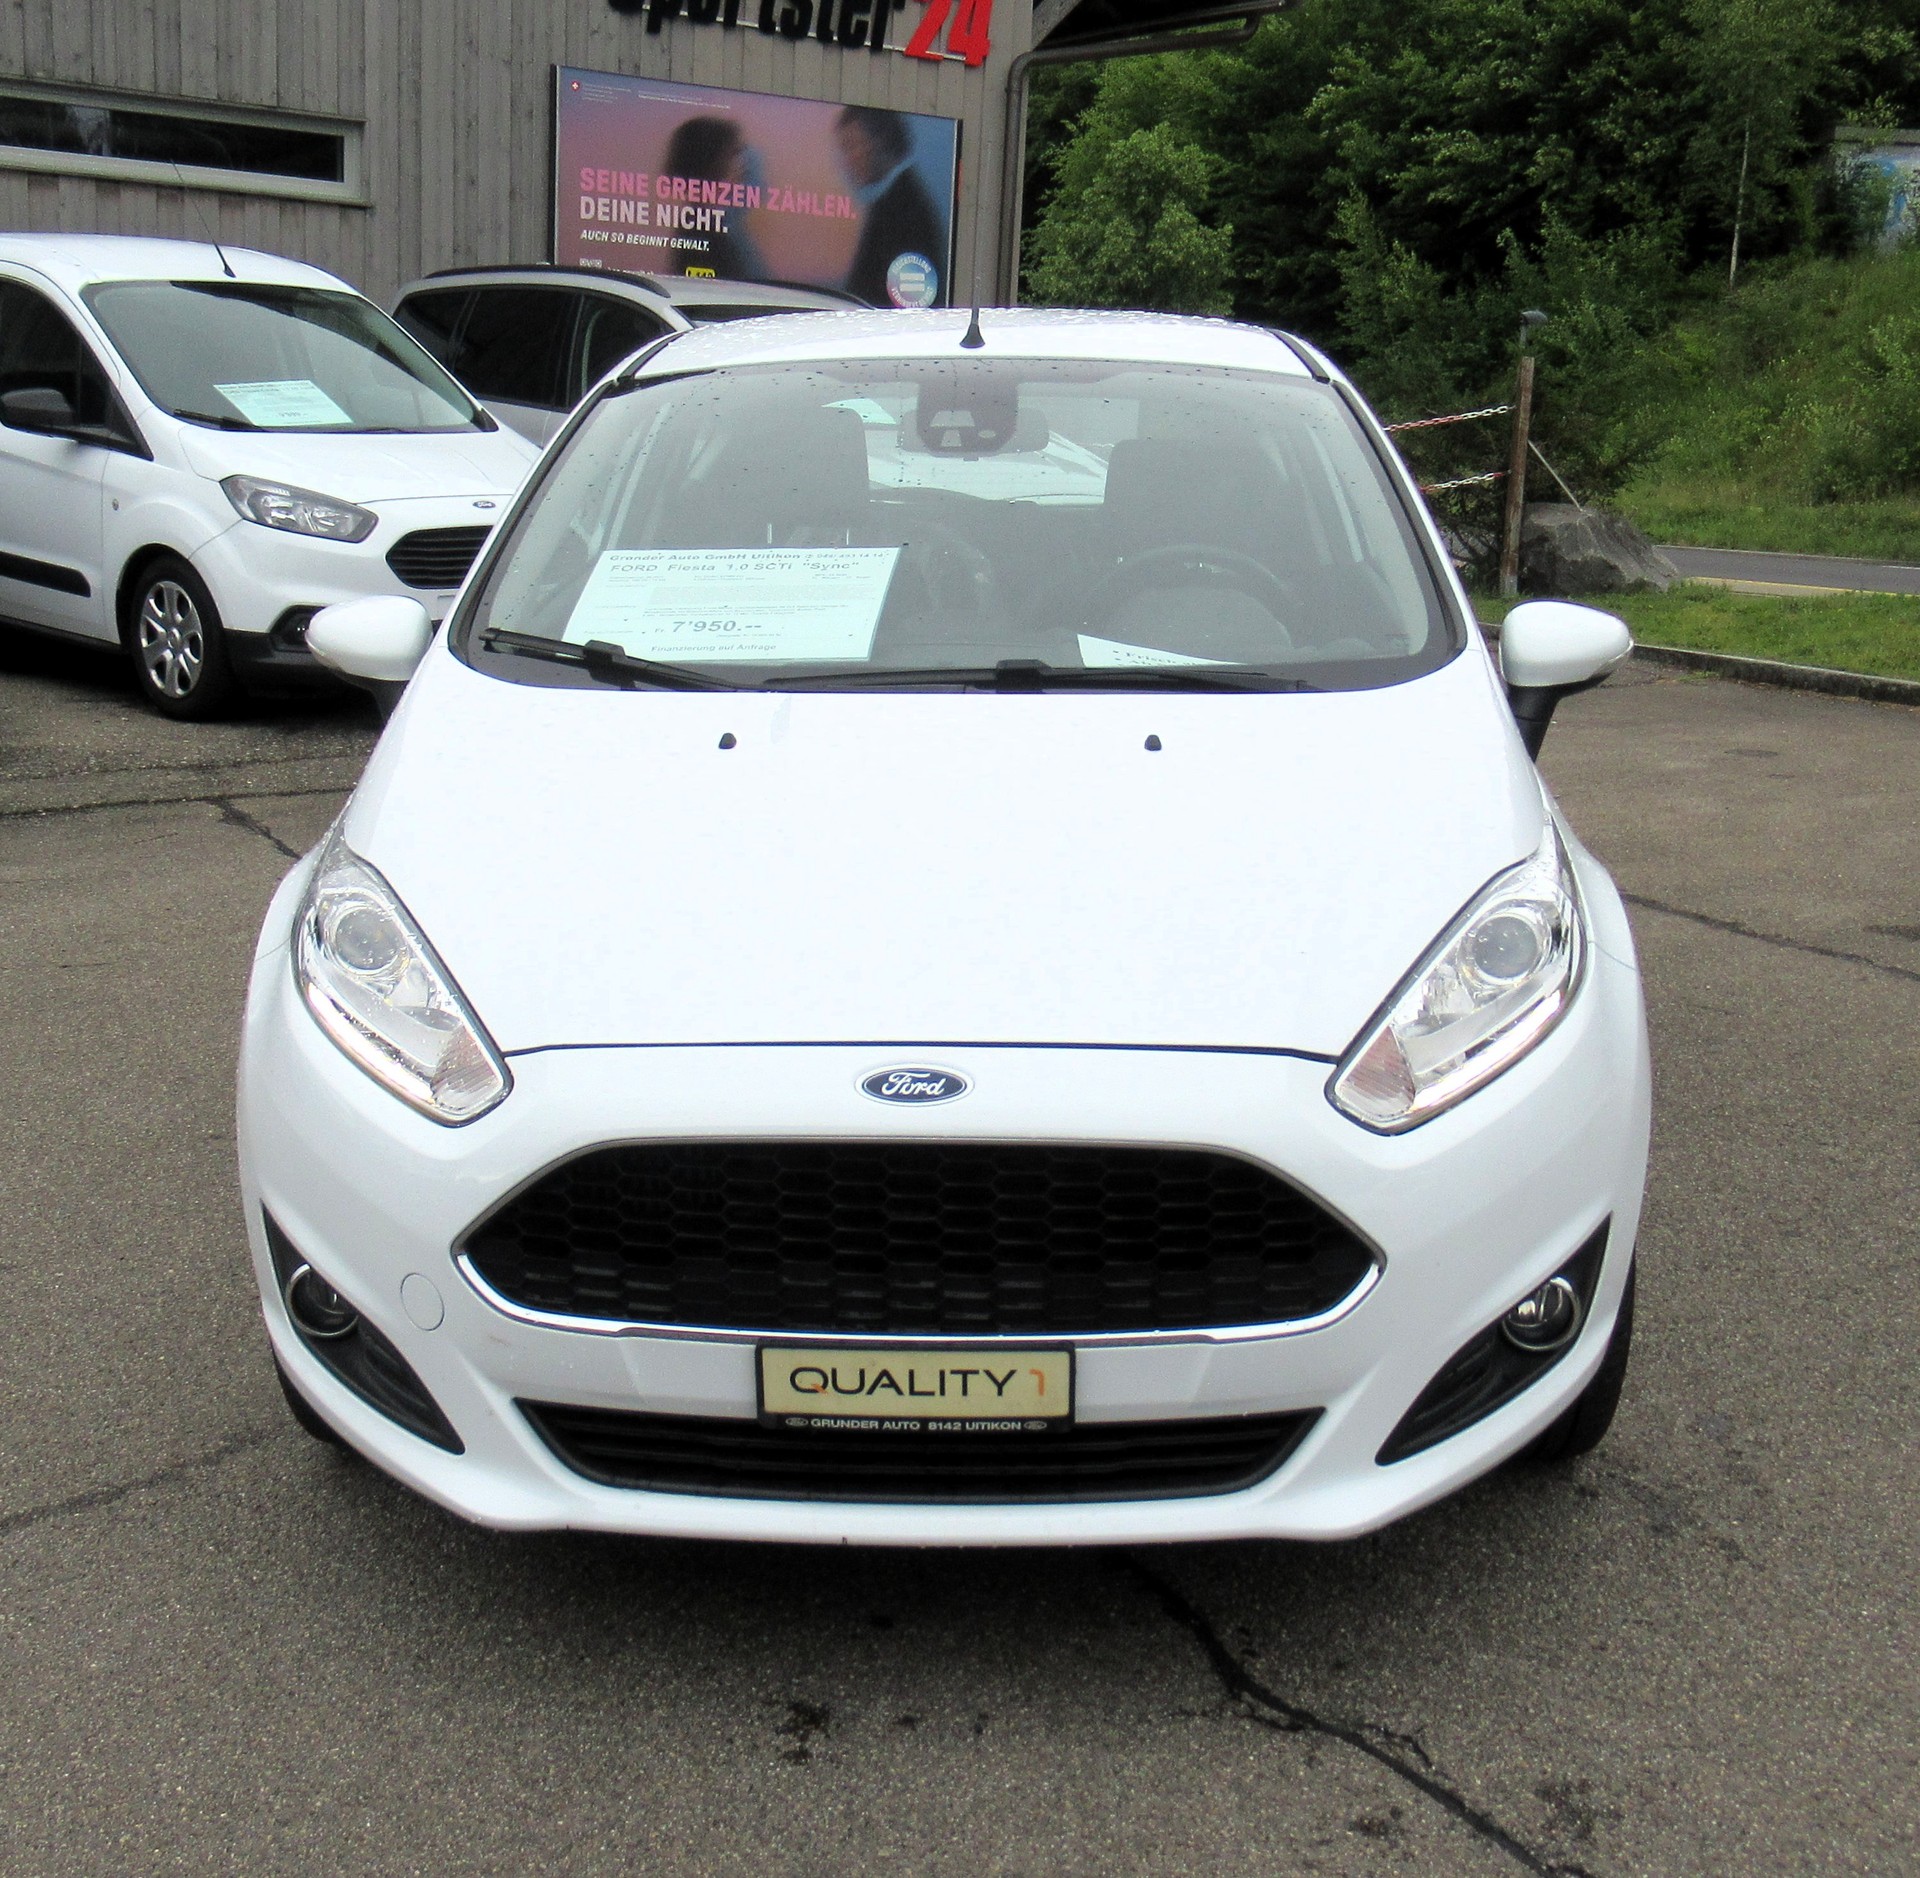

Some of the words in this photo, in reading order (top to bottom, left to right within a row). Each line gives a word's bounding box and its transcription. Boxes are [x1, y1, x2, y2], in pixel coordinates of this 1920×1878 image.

[580, 167, 649, 198] SEINE
[656, 175, 760, 209] GRENZEN
[766, 184, 858, 220] ZÄHLEN.
[580, 195, 650, 226] DEINE
[656, 203, 729, 234] NICHT.
[580, 229, 609, 242] AUCH
[610, 232, 625, 243] SO
[626, 233, 669, 248] BEGINNT
[670, 238, 710, 252] GEWALT.
[667, 553, 700, 561] Auto
[704, 552, 747, 560] GmbH
[610, 564, 658, 572] FORD
[667, 563, 716, 572] Fiesta
[726, 563, 749, 571] 1.0
[803, 561, 860, 571] "Sync"
[672, 620, 762, 632] 7'950.--
[737, 643, 777, 651] Anfrage
[881, 1071, 946, 1096] Ford
[789, 1366, 1017, 1397] QUALITY
[1029, 1368, 1045, 1397] 1
[810, 1418, 879, 1430] GRUNDER
[882, 1420, 921, 1431] AUTO
[928, 1421, 962, 1431] 8142
[965, 1421, 1021, 1431] UITIKON
